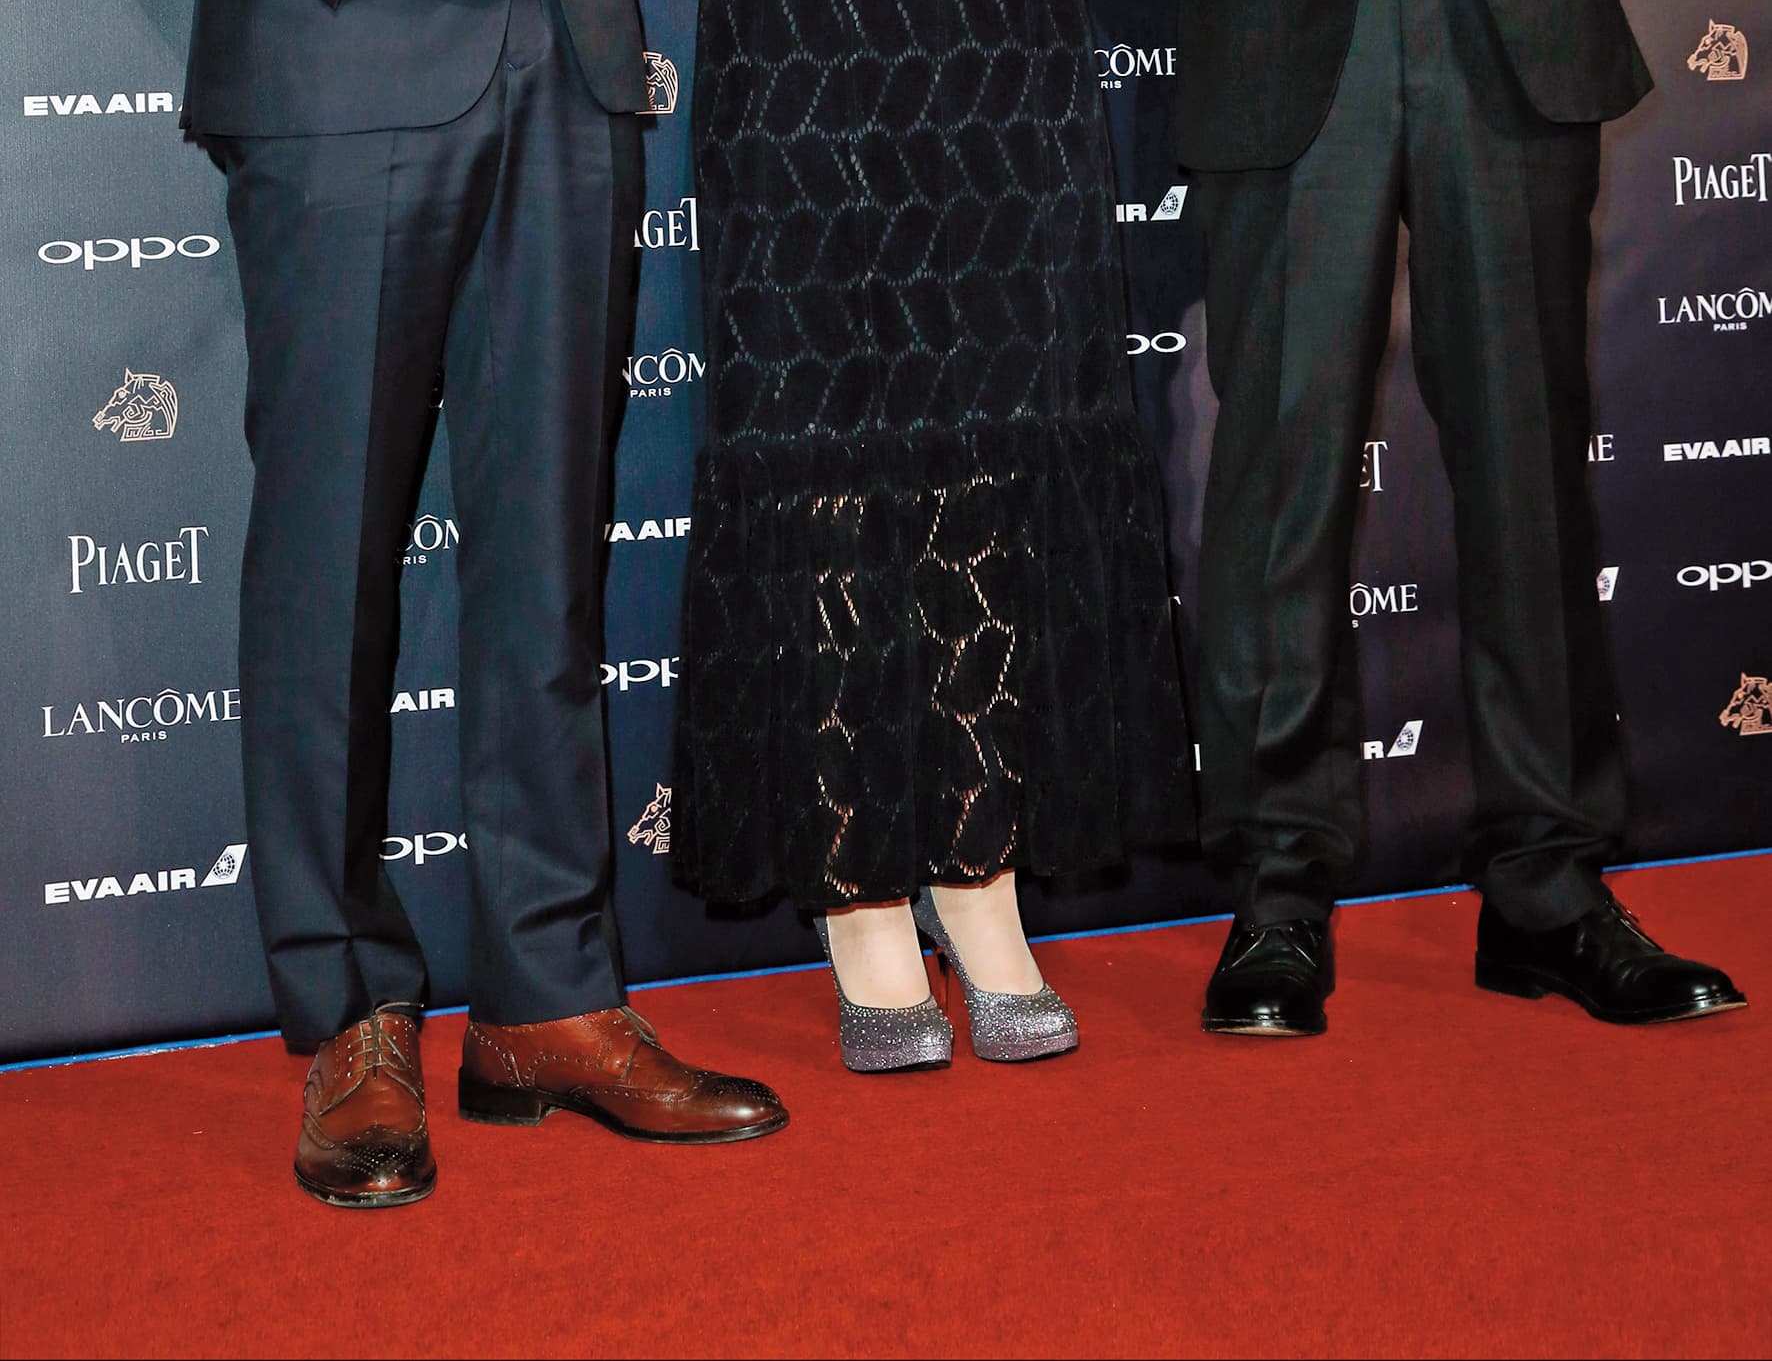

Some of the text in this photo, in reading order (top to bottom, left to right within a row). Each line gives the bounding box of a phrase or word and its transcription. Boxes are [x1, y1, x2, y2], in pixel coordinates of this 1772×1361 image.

[1100, 80, 1122, 89] RIS
[1713, 321, 1748, 332] PARIS
[630, 387, 672, 398] PARIS
[402, 554, 427, 565] RIS
[1676, 560, 1772, 592] opp
[390, 687, 457, 714] AIR
[120, 730, 167, 744] PARIS
